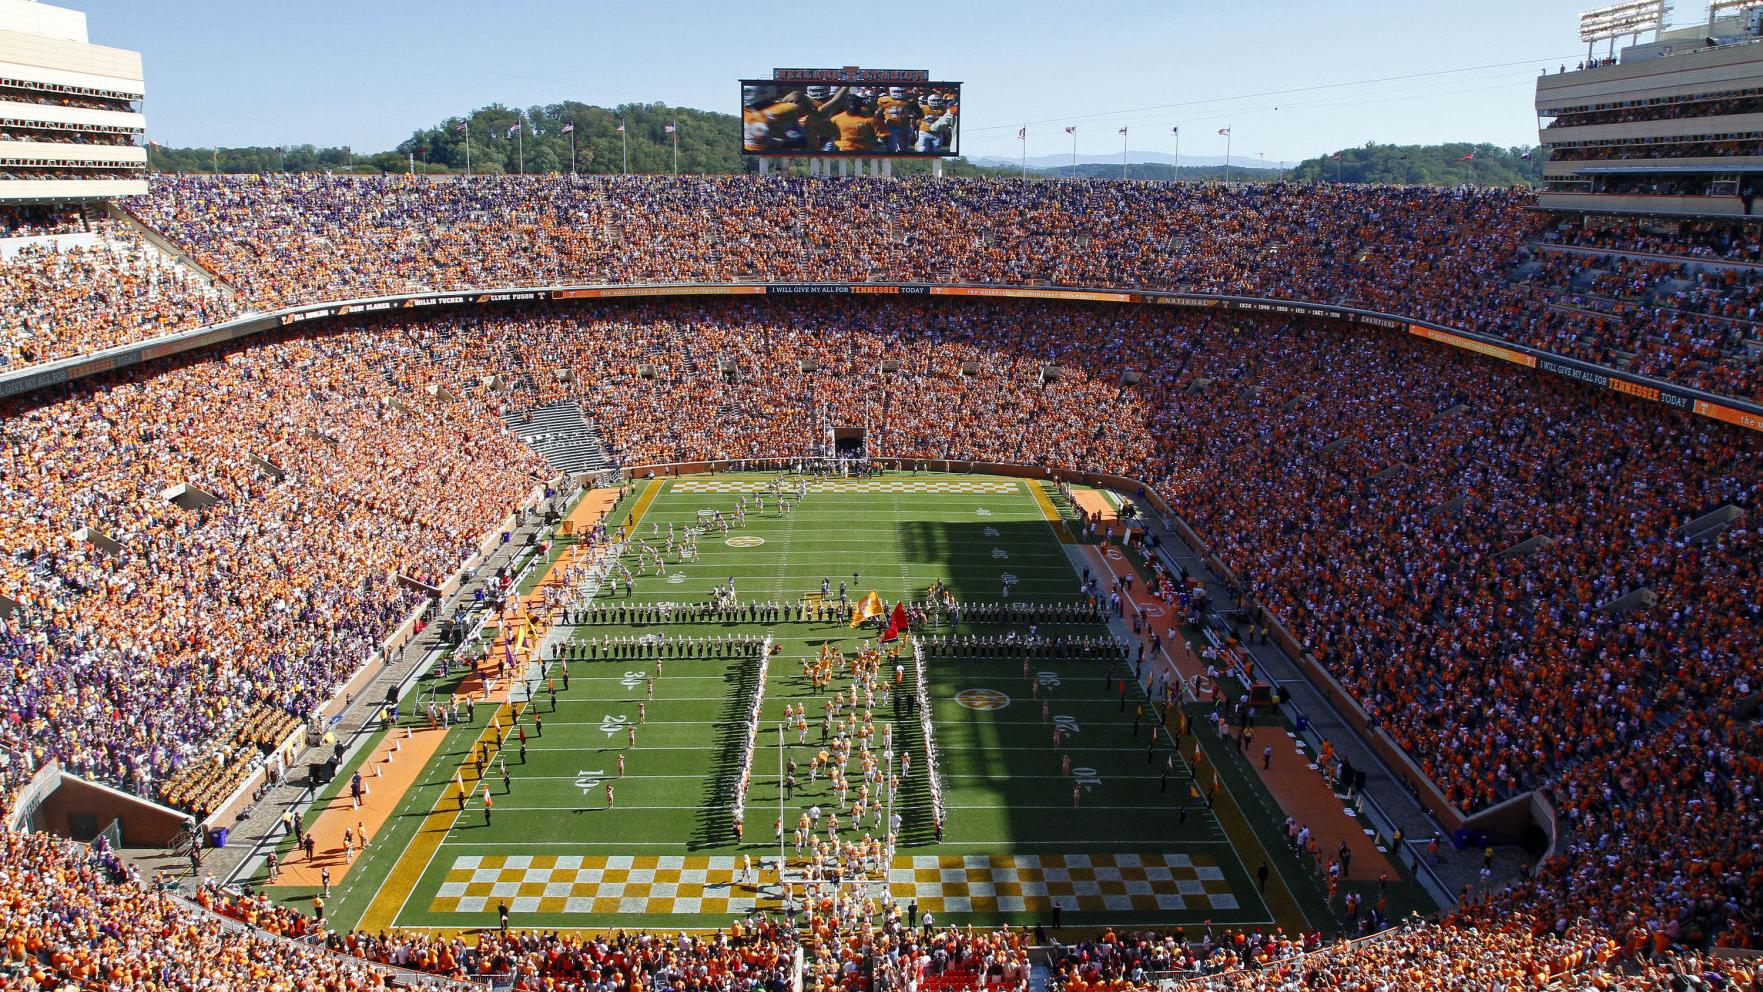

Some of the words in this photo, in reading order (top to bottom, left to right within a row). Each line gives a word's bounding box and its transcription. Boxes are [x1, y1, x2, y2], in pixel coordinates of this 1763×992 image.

[850, 286, 900, 294] TENNESSEE
[414, 298, 436, 306] WILLIS
[438, 297, 464, 305] TUCKER
[1165, 297, 1208, 307] NATIONAL
[1544, 361, 1557, 373] WILL
[1557, 365, 1572, 376] GIVE
[1572, 368, 1582, 379] MY
[1582, 372, 1594, 382] ALL
[1594, 374, 1607, 386] FOR
[1608, 377, 1660, 401] TENNESSEE
[1661, 392, 1688, 407] TODAY
[599, 714, 628, 732] 20
[574, 769, 604, 788] 10
